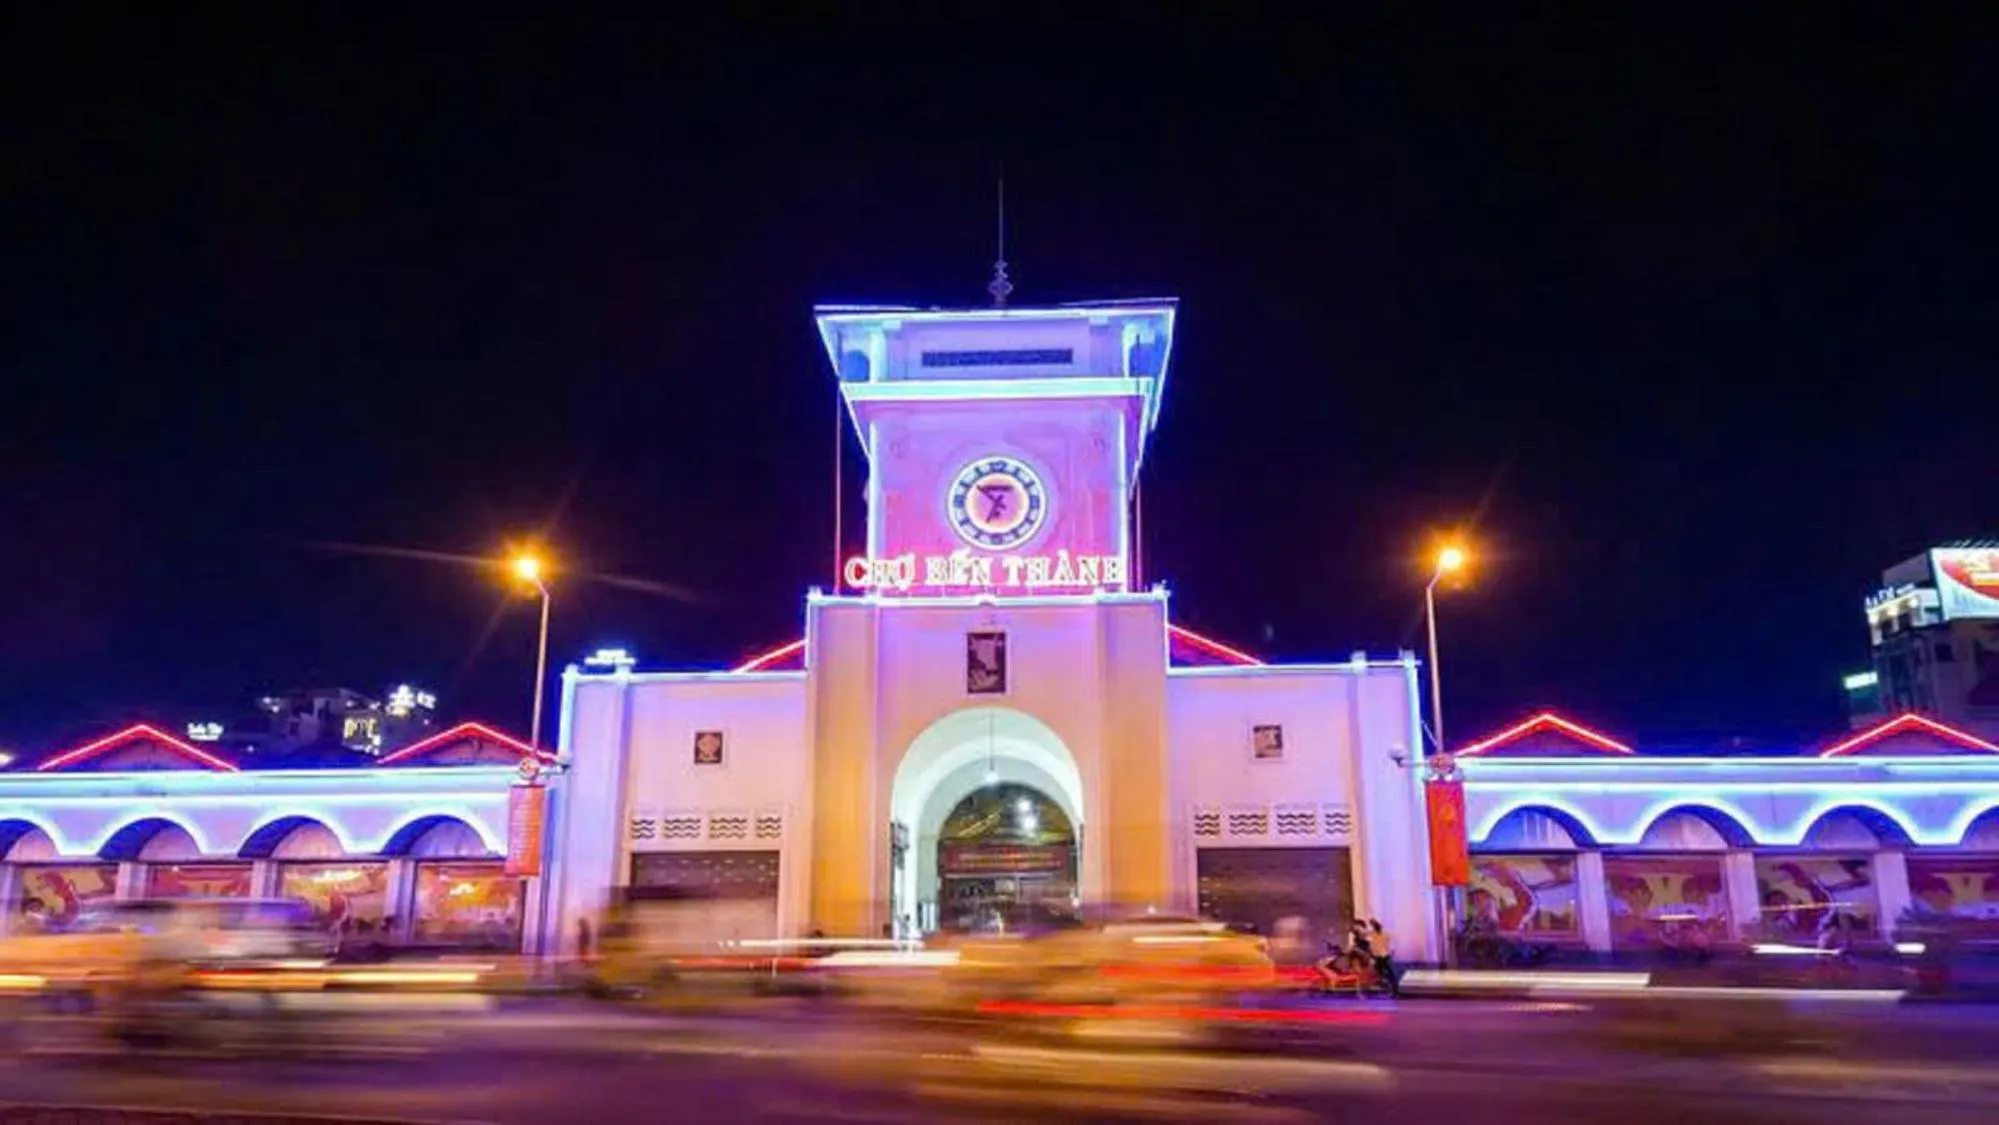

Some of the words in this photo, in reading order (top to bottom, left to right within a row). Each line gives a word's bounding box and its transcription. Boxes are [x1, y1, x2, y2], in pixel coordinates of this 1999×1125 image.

[844, 553, 916, 590] CHỢ
[925, 548, 993, 586] BẾN
[1002, 549, 1126, 586] THÀNH
